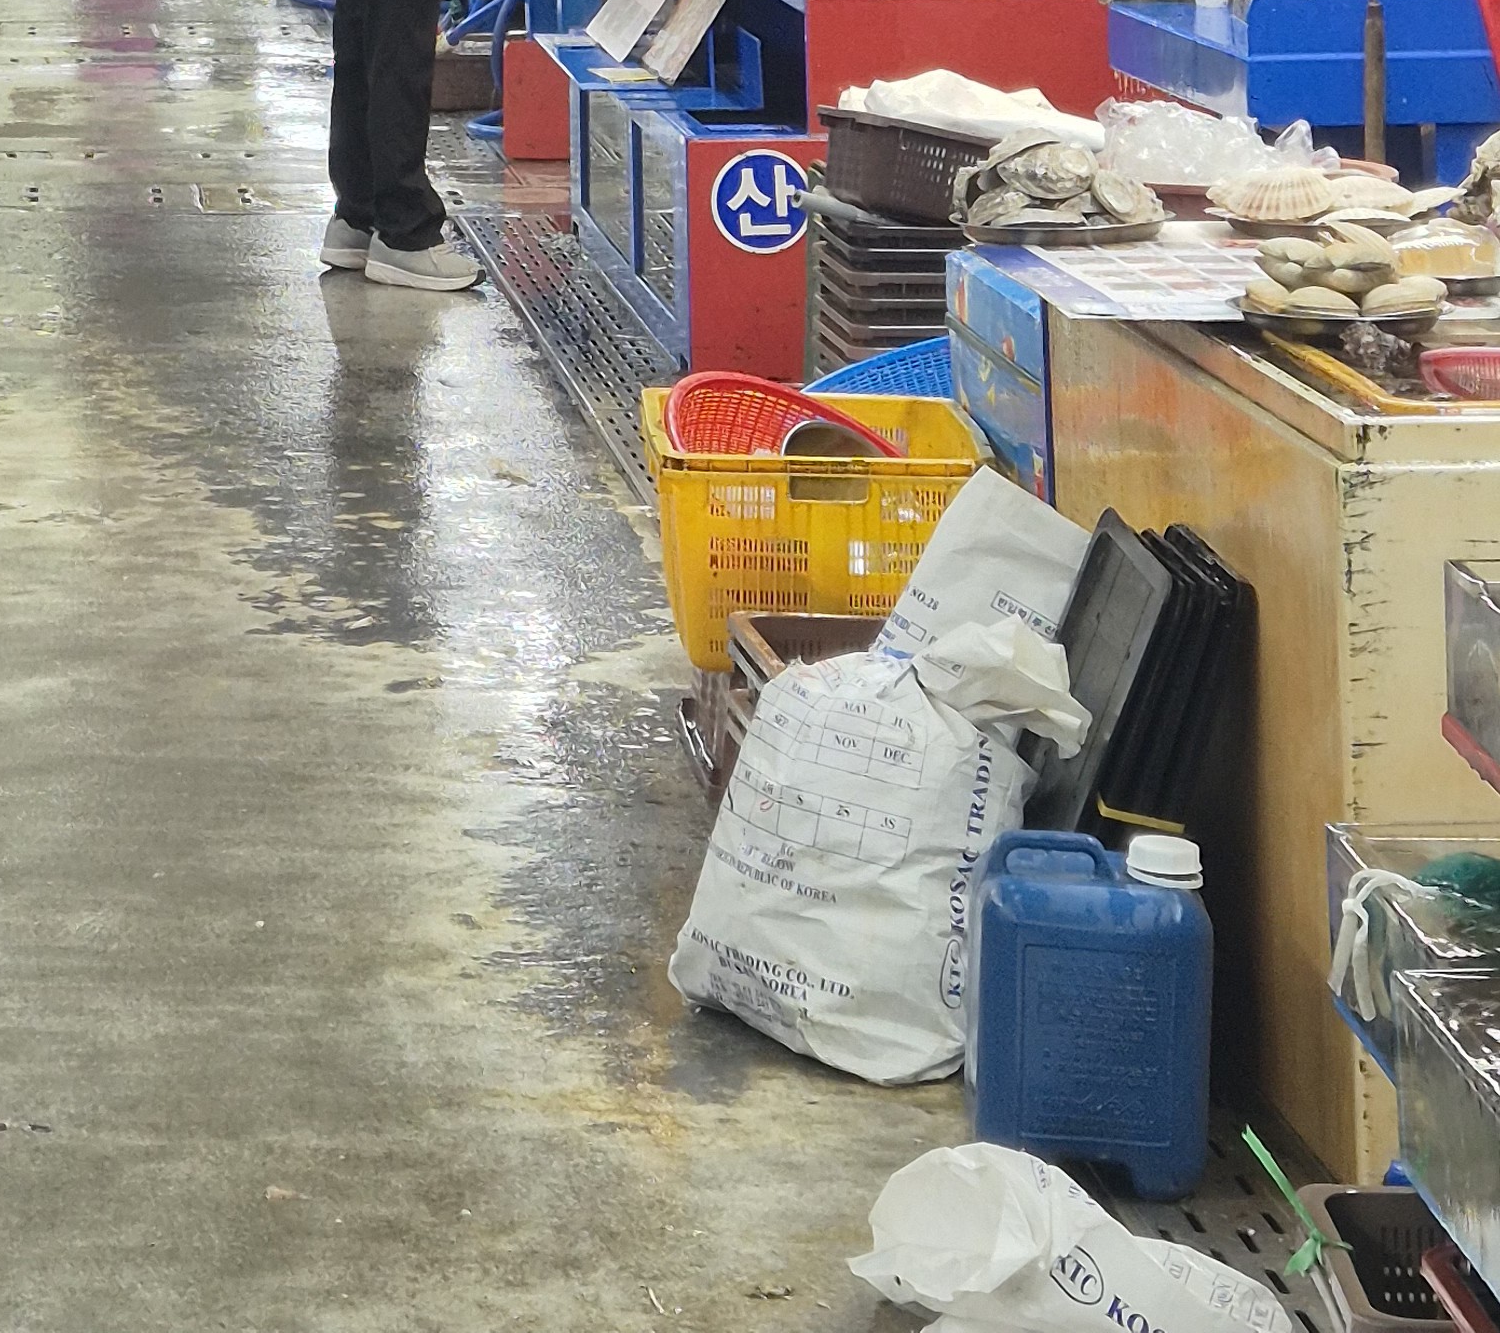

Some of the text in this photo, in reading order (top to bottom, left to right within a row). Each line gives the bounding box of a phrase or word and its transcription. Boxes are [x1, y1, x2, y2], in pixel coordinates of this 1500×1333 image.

[726, 164, 796, 237] 산
[781, 878, 795, 892] OF
[796, 883, 838, 904] KOREA
[947, 733, 993, 998] KTC KOSAC TRADIN
[722, 944, 784, 978] TRADING
[820, 978, 856, 1000] LTD.
[761, 975, 809, 1002] KOREA
